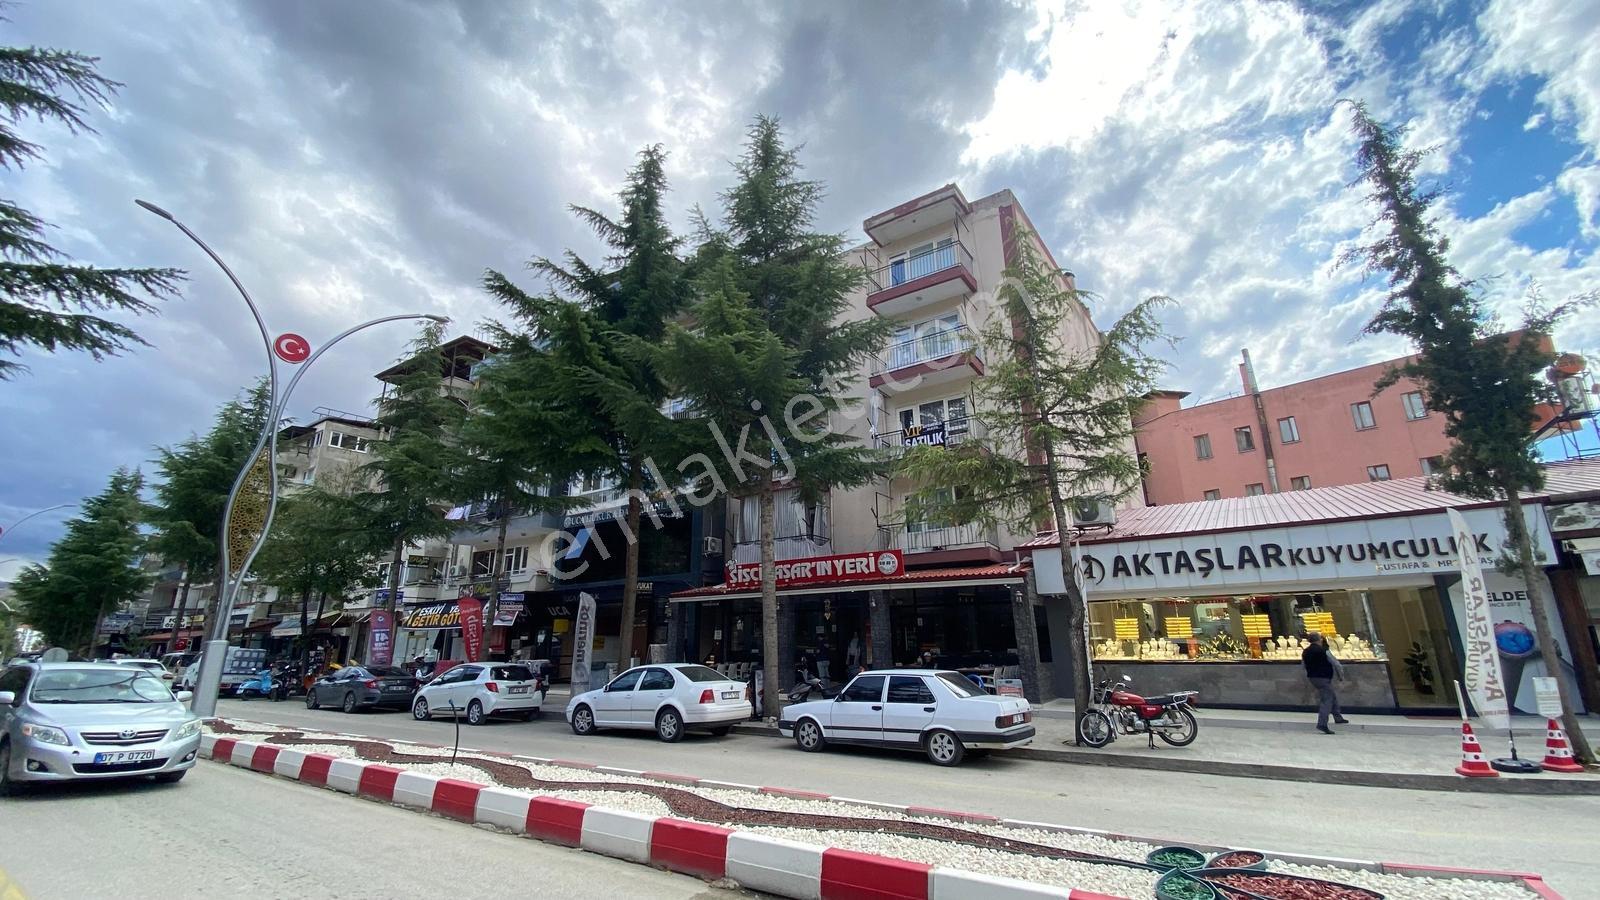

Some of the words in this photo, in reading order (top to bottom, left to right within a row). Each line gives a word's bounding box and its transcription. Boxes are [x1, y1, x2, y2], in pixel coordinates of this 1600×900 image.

[905, 425, 923, 437] VIP
[905, 432, 944, 447] SATILIK
[1112, 543, 1284, 578] AKTAŞLAR
[774, 561, 833, 583] AŞAR'IN
[835, 552, 876, 576] YERİ
[1486, 590, 1530, 602] ELDE
[102, 753, 114, 762] 07
[118, 752, 125, 761] P
[128, 751, 153, 761] 0720
